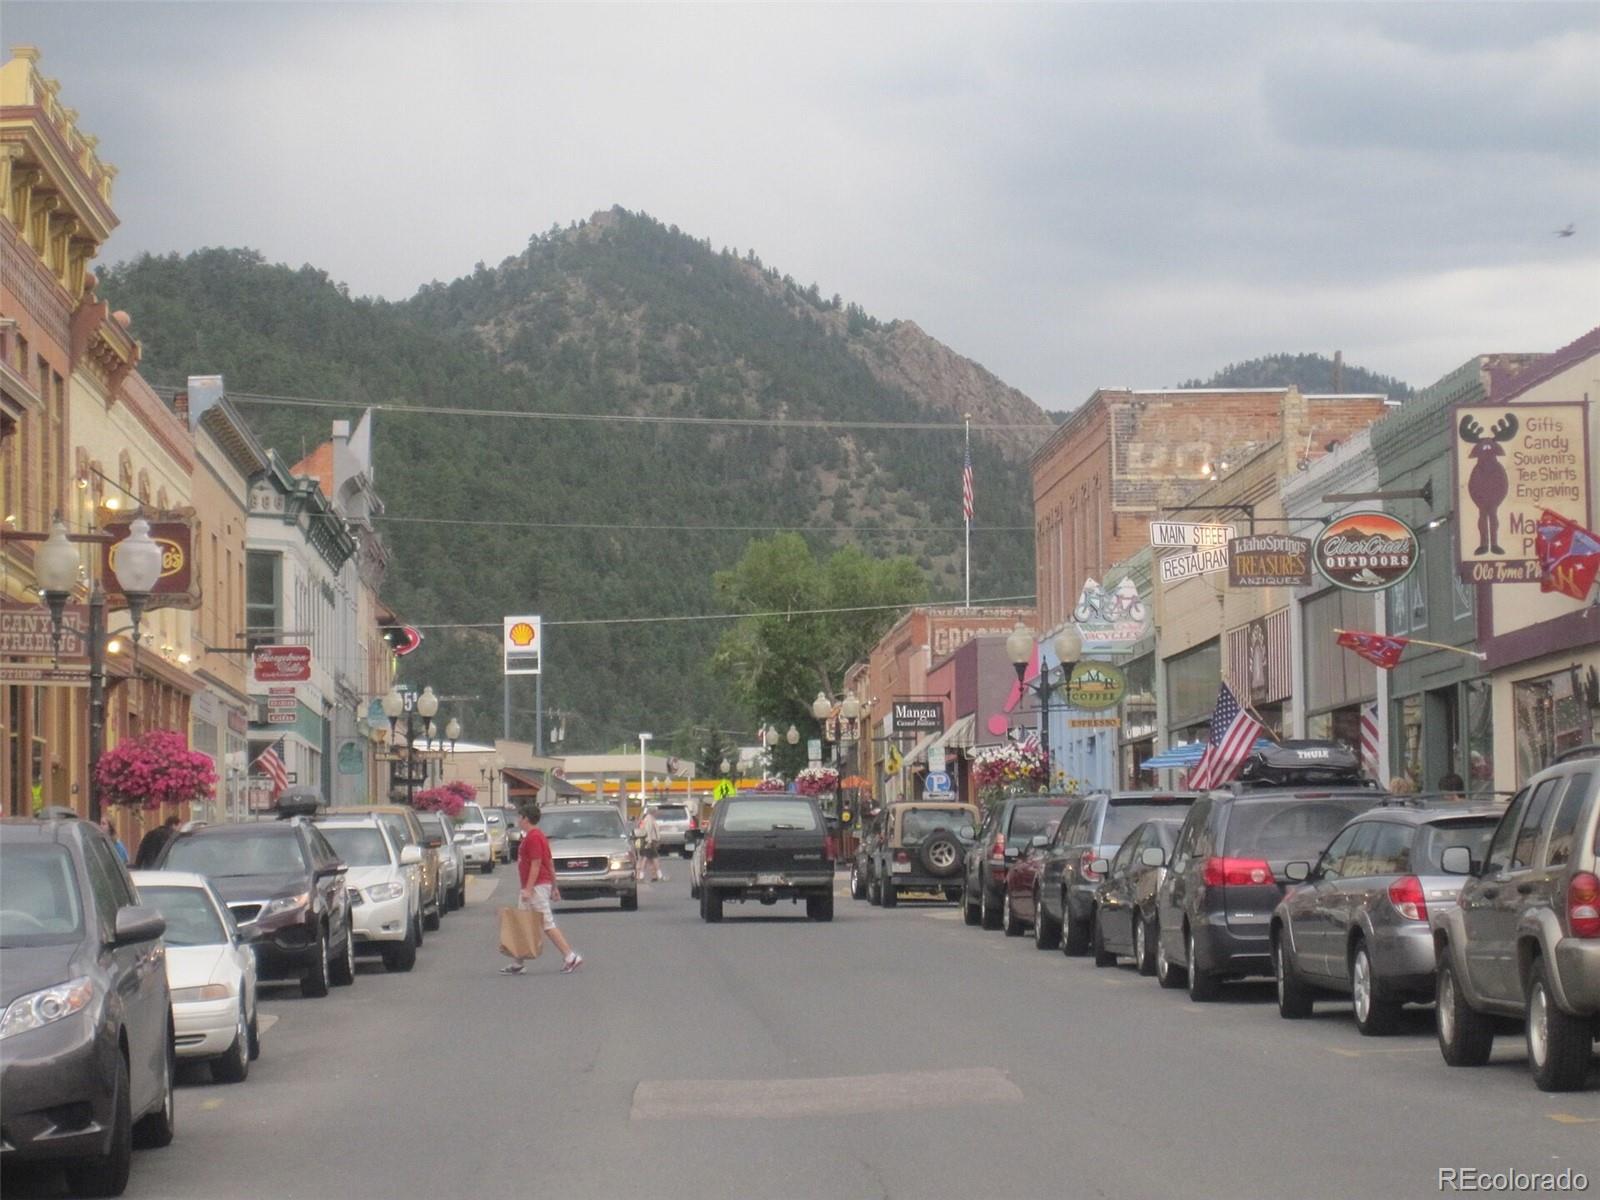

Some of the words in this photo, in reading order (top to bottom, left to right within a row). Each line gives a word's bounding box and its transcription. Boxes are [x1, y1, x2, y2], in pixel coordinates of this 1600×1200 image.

[1526, 416, 1563, 433] Gifts
[1524, 436, 1569, 453] Candy
[1514, 452, 1576, 466] Souvenirs
[1517, 468, 1537, 482] Tee
[1541, 467, 1577, 481] Shirts
[1516, 484, 1579, 501] Engraving
[1159, 525, 1186, 544] MAIN
[1193, 526, 1229, 545] STREET
[1323, 536, 1366, 556] Clear
[1365, 535, 1410, 555] Creek
[1163, 551, 1228, 580] RESTAURAN
[1234, 555, 1306, 576] TREASURES
[1326, 555, 1409, 568] OUTDOORS
[1473, 563, 1494, 581] Ole
[1239, 577, 1302, 585] ANTIQUES
[1, 614, 76, 633] CANYN
[1071, 692, 1115, 701] COFFEE
[1071, 719, 1117, 728] ESPRESSO
[1296, 750, 1329, 758] THULE
[931, 774, 946, 794] P
